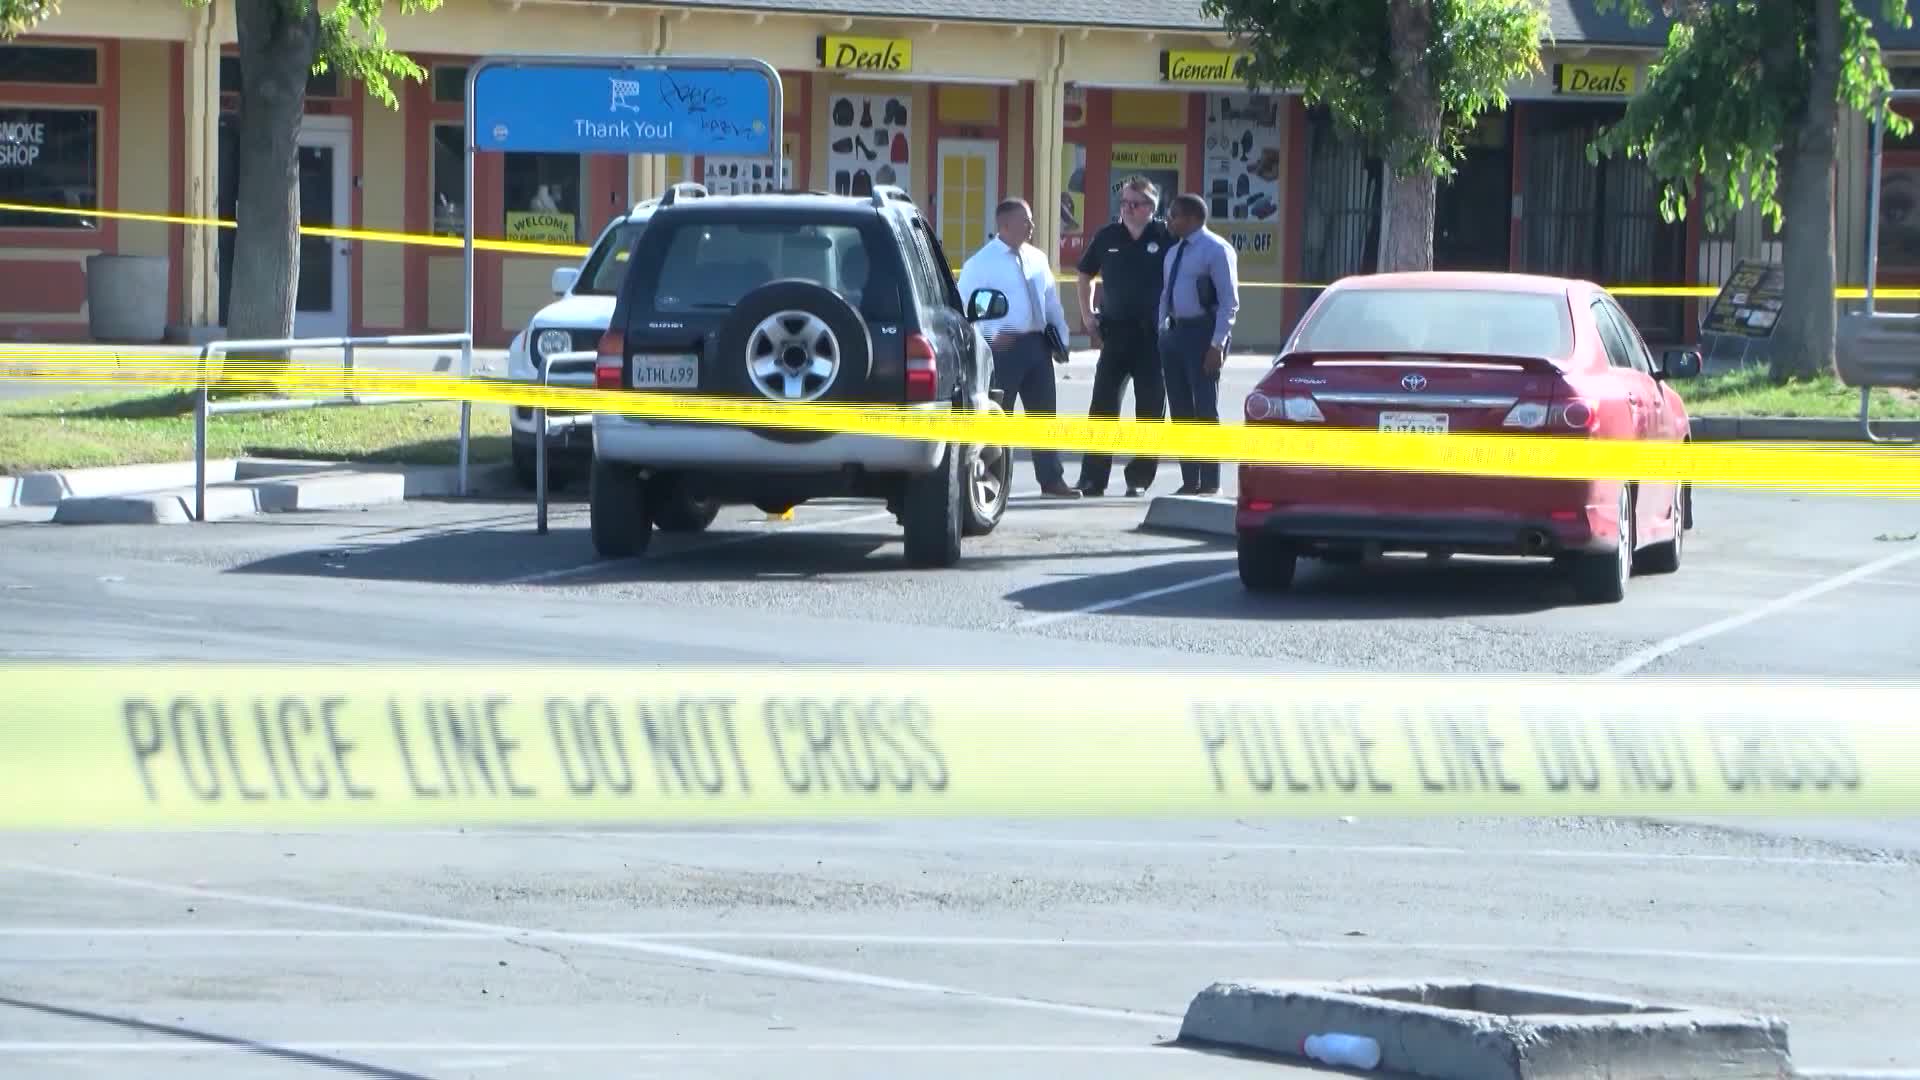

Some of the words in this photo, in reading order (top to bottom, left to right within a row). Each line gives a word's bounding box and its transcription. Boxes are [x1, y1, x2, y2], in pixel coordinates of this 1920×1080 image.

[835, 41, 902, 69] Deals
[1172, 55, 1231, 80] General
[1571, 65, 1627, 92] Deals
[0, 121, 45, 144] MOKE
[576, 119, 630, 138] Thank
[635, 119, 673, 138] You!
[513, 215, 569, 232] WELCOME
[1254, 232, 1272, 252] OFF
[637, 366, 694, 384] 4THL499
[124, 695, 377, 801] POLICE
[386, 696, 538, 799] LINE
[542, 696, 634, 795] DO
[638, 697, 753, 794] NOT
[762, 697, 950, 793] CROSS
[1192, 702, 1394, 792] POLICE
[1397, 704, 1521, 791] LINE
[1519, 705, 1601, 793] DO
[1600, 710, 1698, 792] NOT
[1703, 711, 1859, 792] CROSS
